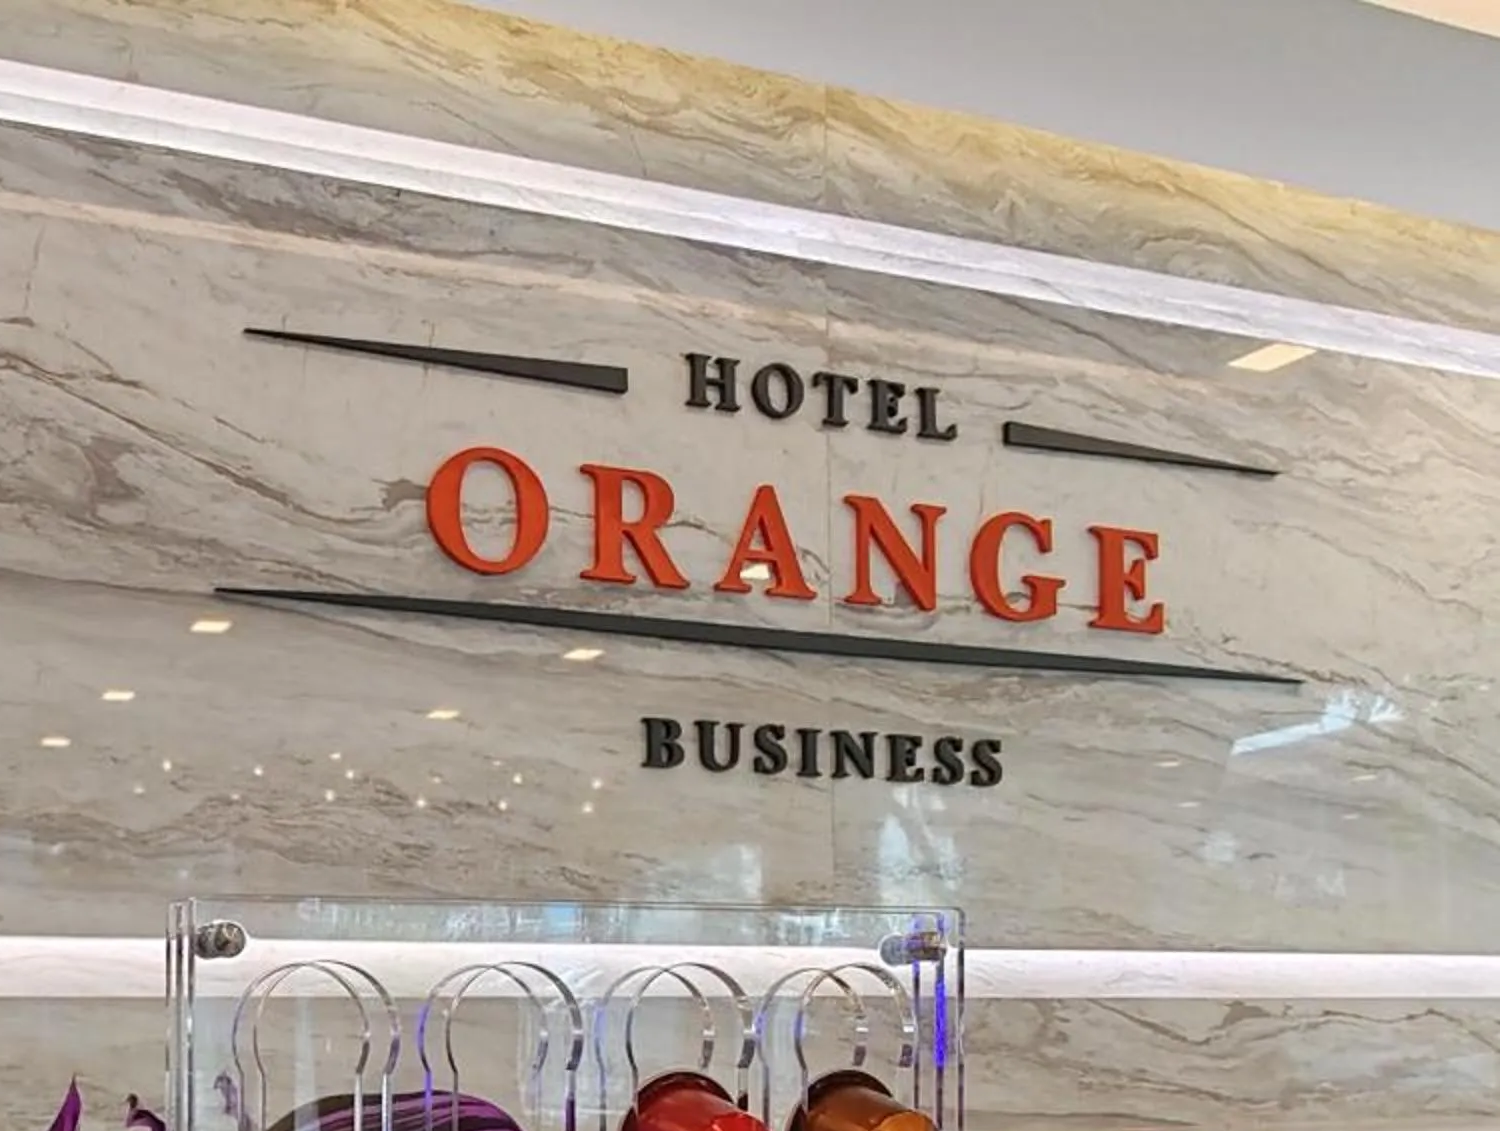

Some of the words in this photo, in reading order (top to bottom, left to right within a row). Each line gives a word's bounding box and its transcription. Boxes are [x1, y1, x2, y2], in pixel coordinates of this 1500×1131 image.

[684, 351, 958, 443] HOTEL
[424, 444, 1168, 637] ORANGE
[639, 716, 1004, 789] BUSINESS
